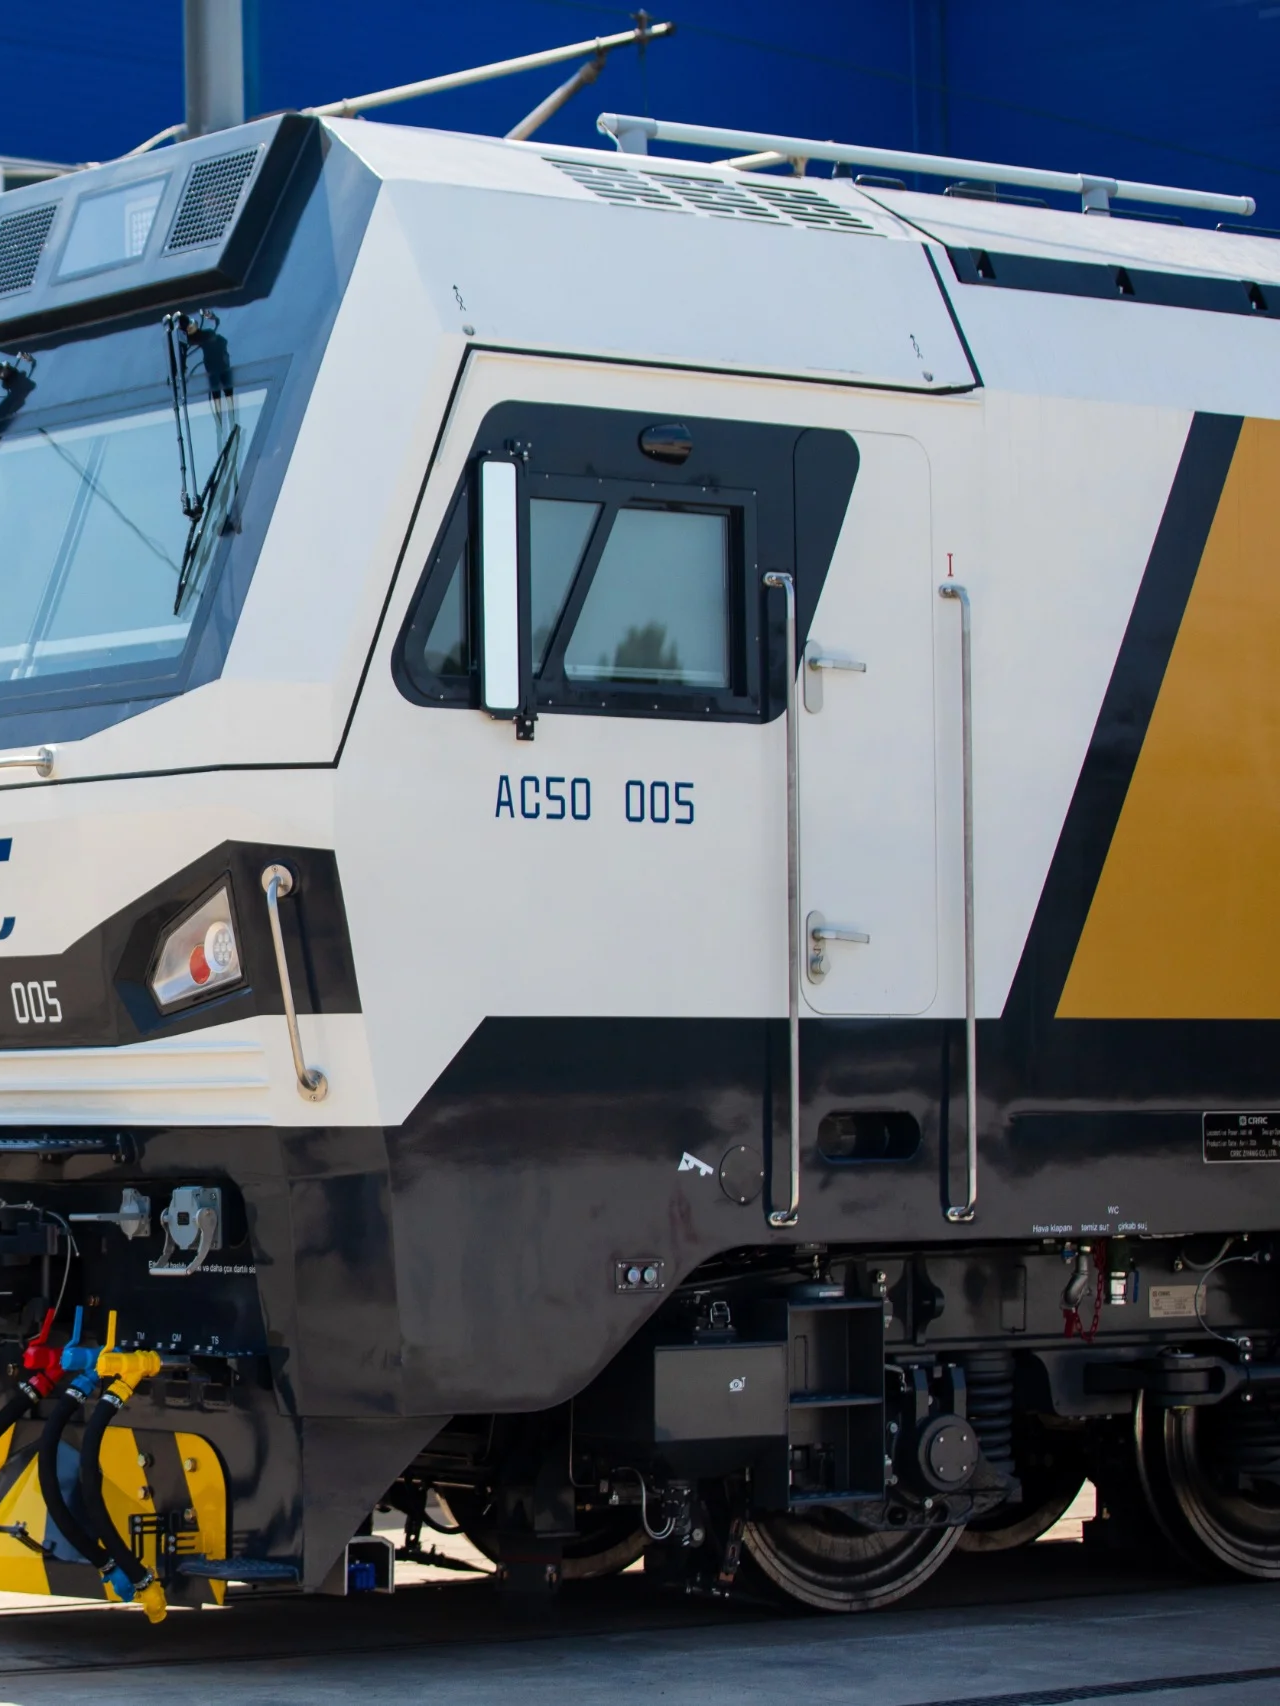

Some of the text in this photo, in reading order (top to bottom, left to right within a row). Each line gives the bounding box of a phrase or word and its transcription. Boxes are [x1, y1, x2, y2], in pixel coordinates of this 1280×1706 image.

[495, 775, 694, 824] AC50 005
[11, 981, 63, 1024] 005
[1107, 1205, 1119, 1215] WC
[1032, 1224, 1049, 1233] Hava
[210, 1263, 223, 1273] daha
[136, 1331, 145, 1340] TM
[211, 1335, 219, 1345] TS
